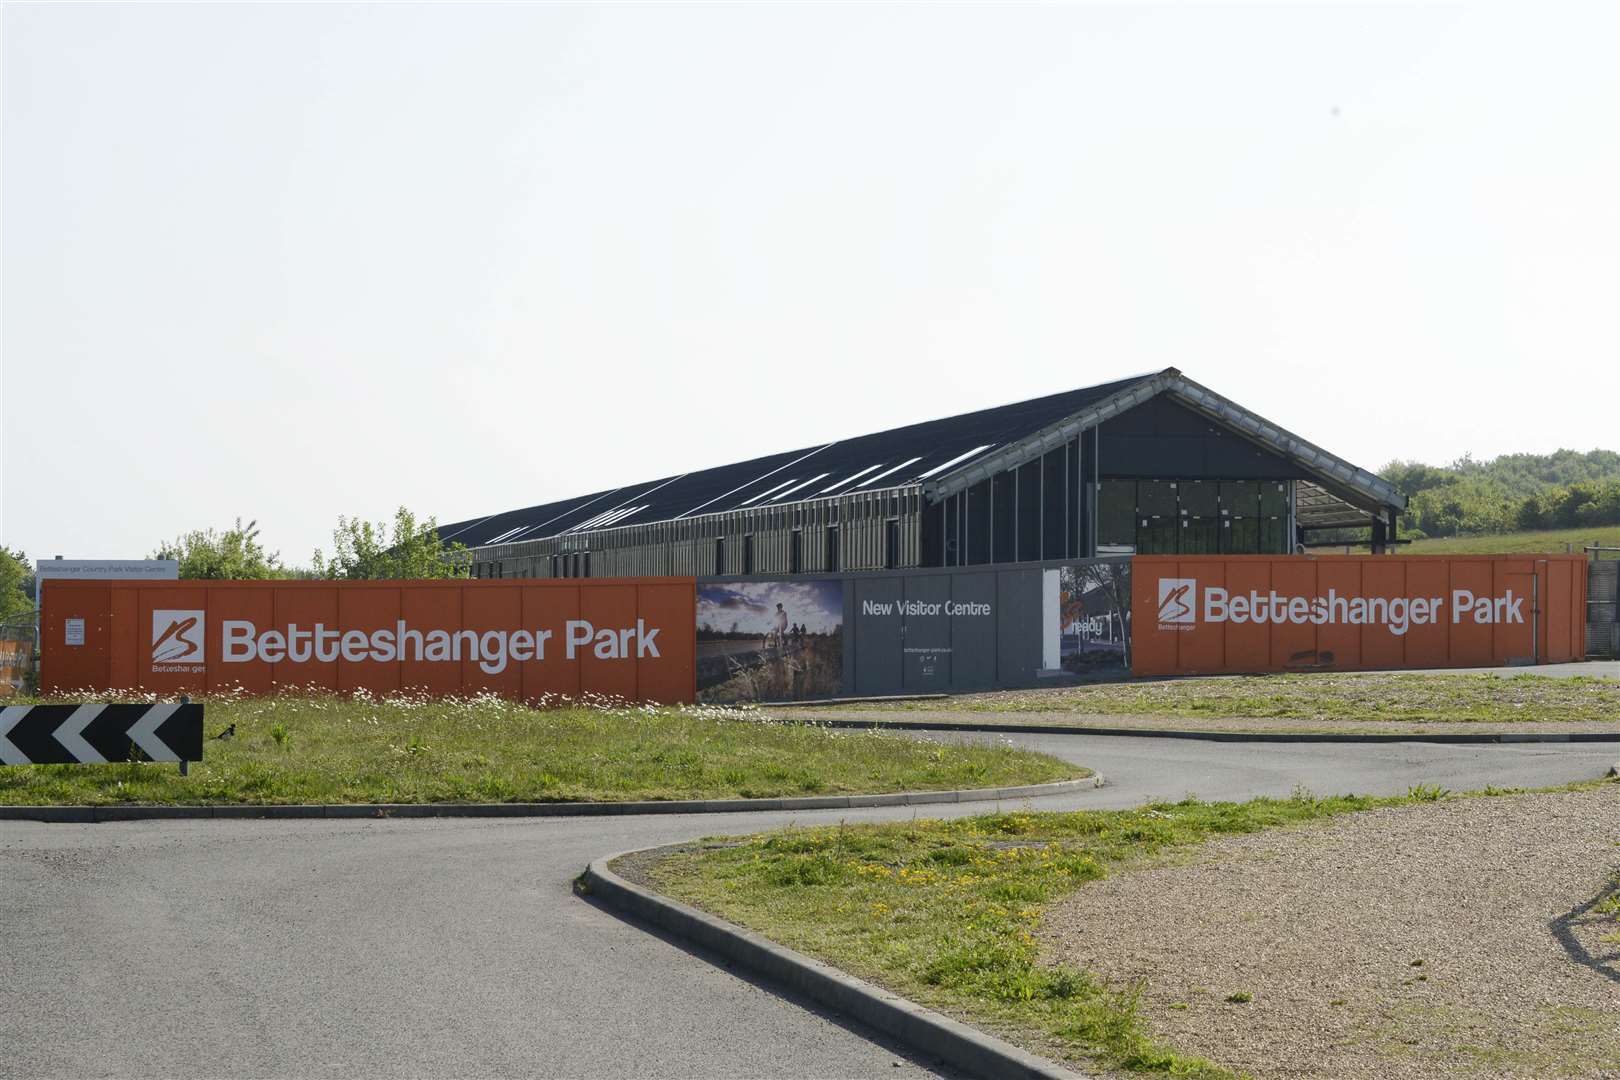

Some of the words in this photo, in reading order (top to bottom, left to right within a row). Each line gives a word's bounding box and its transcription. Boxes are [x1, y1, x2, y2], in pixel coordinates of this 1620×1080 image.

[862, 600, 893, 616] New
[896, 600, 942, 616] Visitor
[944, 600, 992, 616] Centre
[1204, 587, 1443, 635] Betteshanger
[1452, 589, 1525, 624] Park
[1072, 616, 1104, 636] ready
[222, 619, 552, 675] Betteshanger
[565, 618, 661, 660] Park
